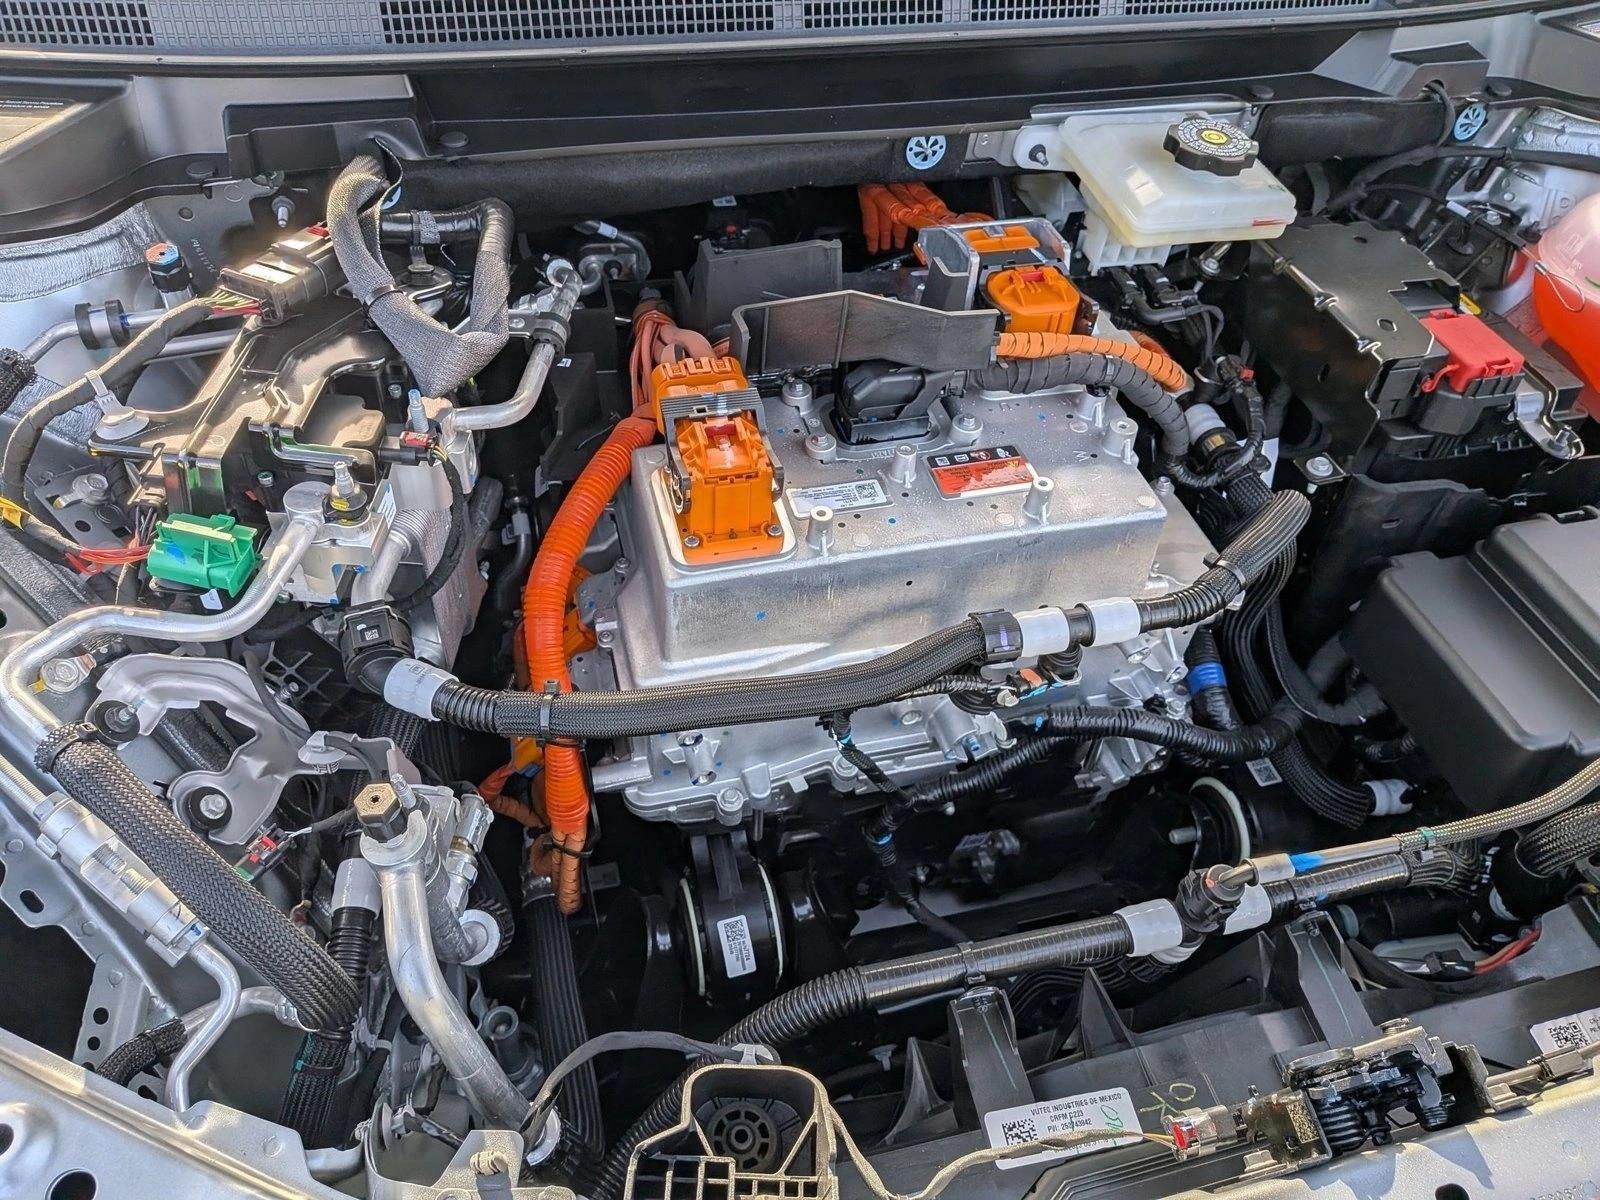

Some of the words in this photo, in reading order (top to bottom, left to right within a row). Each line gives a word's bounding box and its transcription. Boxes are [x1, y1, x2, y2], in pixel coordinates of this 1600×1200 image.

[1052, 1099, 1089, 1112] INDUSTRIES
[1089, 1097, 1098, 1105] DE
[1099, 1093, 1122, 1103] MEXICO
[1050, 1112, 1068, 1122] CRFM
